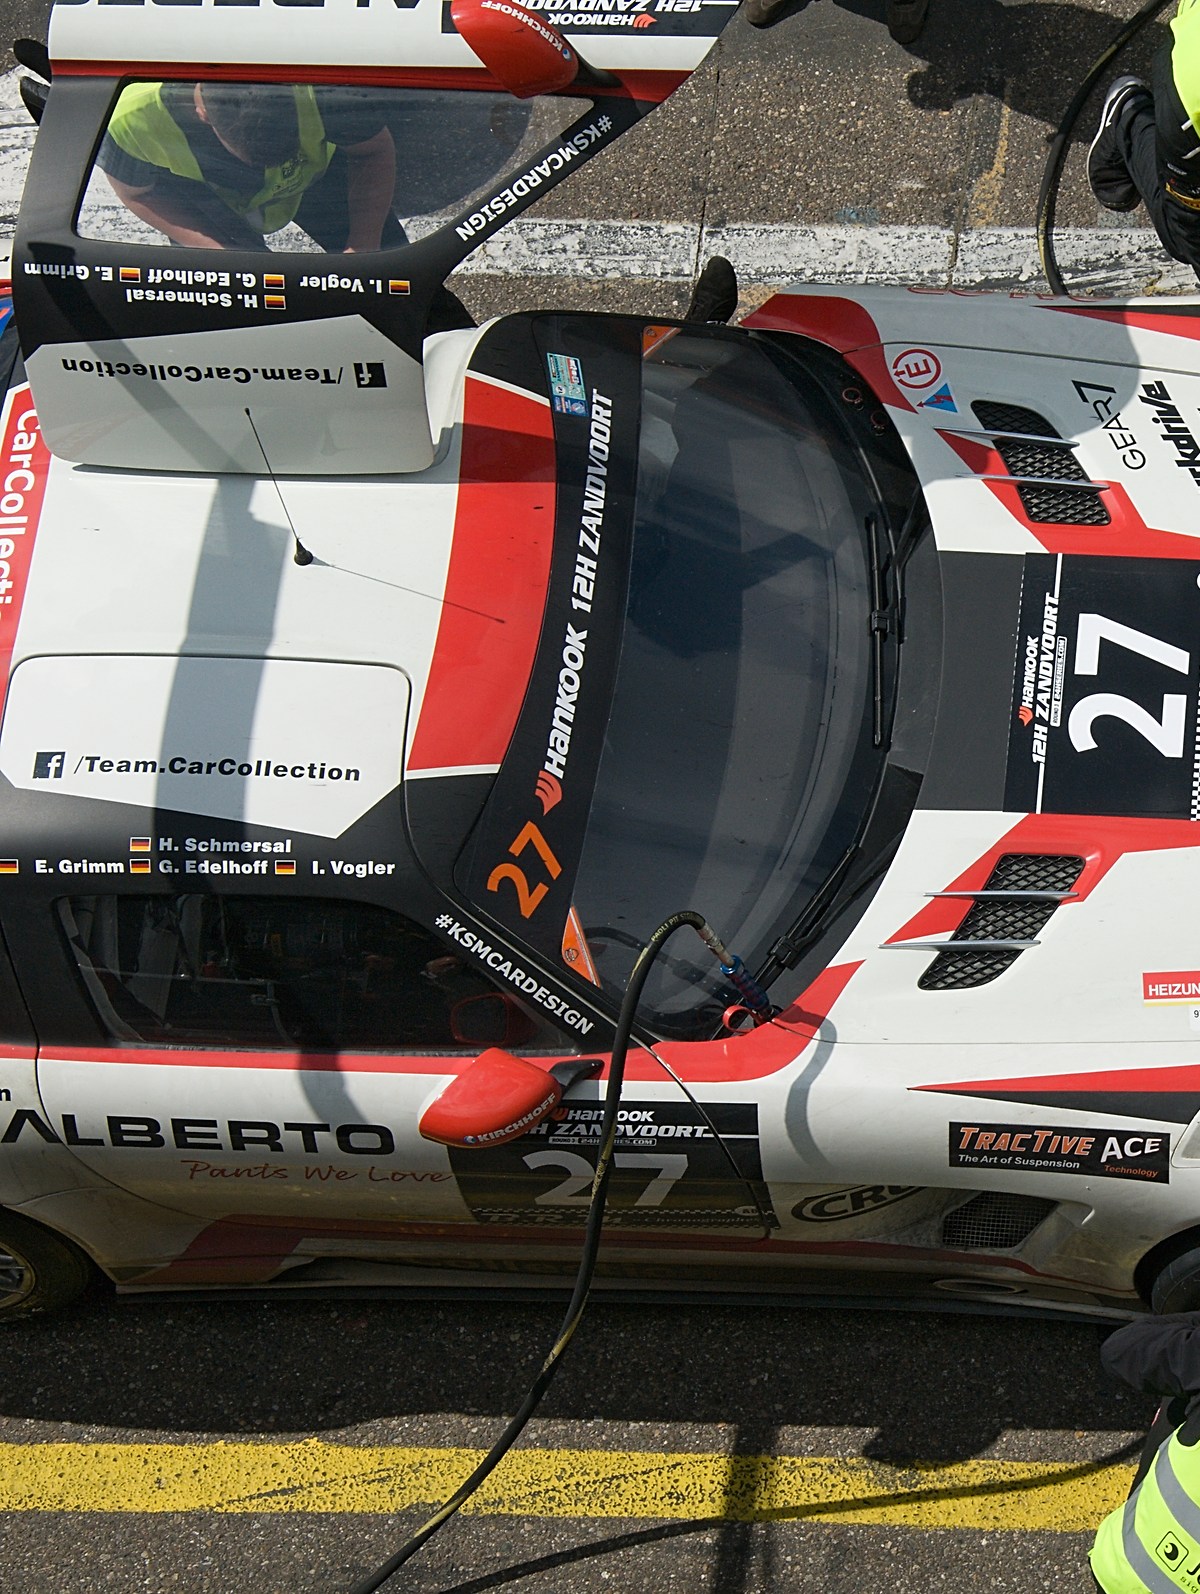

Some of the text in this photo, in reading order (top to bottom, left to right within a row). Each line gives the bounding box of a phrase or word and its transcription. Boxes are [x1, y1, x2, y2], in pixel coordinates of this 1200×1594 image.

[512, 0, 651, 12] ZANDVOO
[481, 1, 564, 52] KIRCHHOFF
[455, 114, 614, 243] #KSMCARDESIGN
[24, 262, 114, 282] E. Grimm
[147, 267, 258, 289] G. Edelhoff
[300, 275, 383, 295] I. Vogler
[126, 287, 259, 310] H. Schmersal
[61, 357, 345, 387] /Team.CarCollection
[1071, 379, 1147, 471] GEAR7
[579, 388, 614, 556] ZANDVOORT
[571, 553, 600, 614] 12H
[1031, 592, 1059, 765] 12H ZANDVOORT
[1067, 613, 1191, 758] 27
[73, 755, 360, 782] /Team.CarCollection
[159, 837, 292, 853] H. Schmersal
[35, 859, 125, 875] E. Grimm
[158, 859, 268, 875] G. Edelhoff
[312, 860, 396, 878] I. Vogler
[487, 820, 563, 919] 27
[435, 914, 595, 1035] #KSMCARDESIGN
[477, 1092, 557, 1144] KIRCHHOFF
[1, 1109, 396, 1156] ALBERTO
[958, 1154, 1080, 1170] The Art of Suspension
[1100, 1136, 1163, 1163] ACE
[180, 1160, 455, 1183] Pants We Love
[522, 1150, 689, 1207] 27
[1104, 1164, 1159, 1178] Technology
